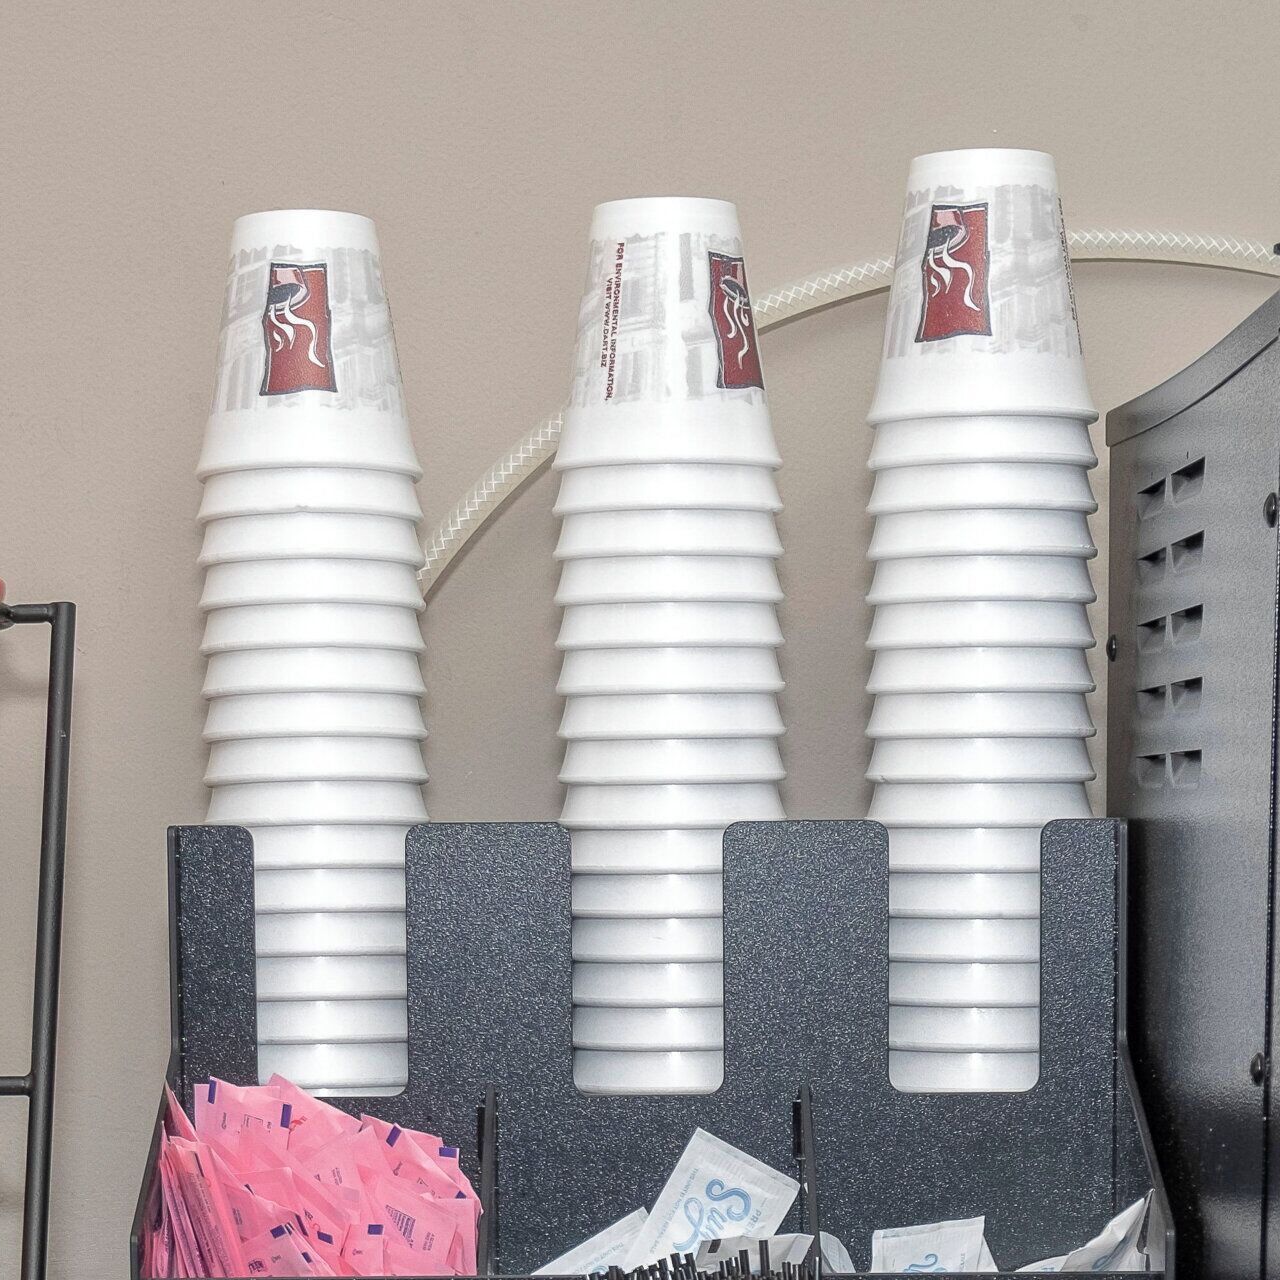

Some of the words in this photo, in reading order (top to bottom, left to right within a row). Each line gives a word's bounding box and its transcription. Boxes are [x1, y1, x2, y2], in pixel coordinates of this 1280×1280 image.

[616, 242, 625, 261] FOR
[605, 278, 614, 299] VISIT
[610, 263, 623, 337] ENVIRONMENTAL
[600, 302, 612, 368] WWW.DART.BIZ
